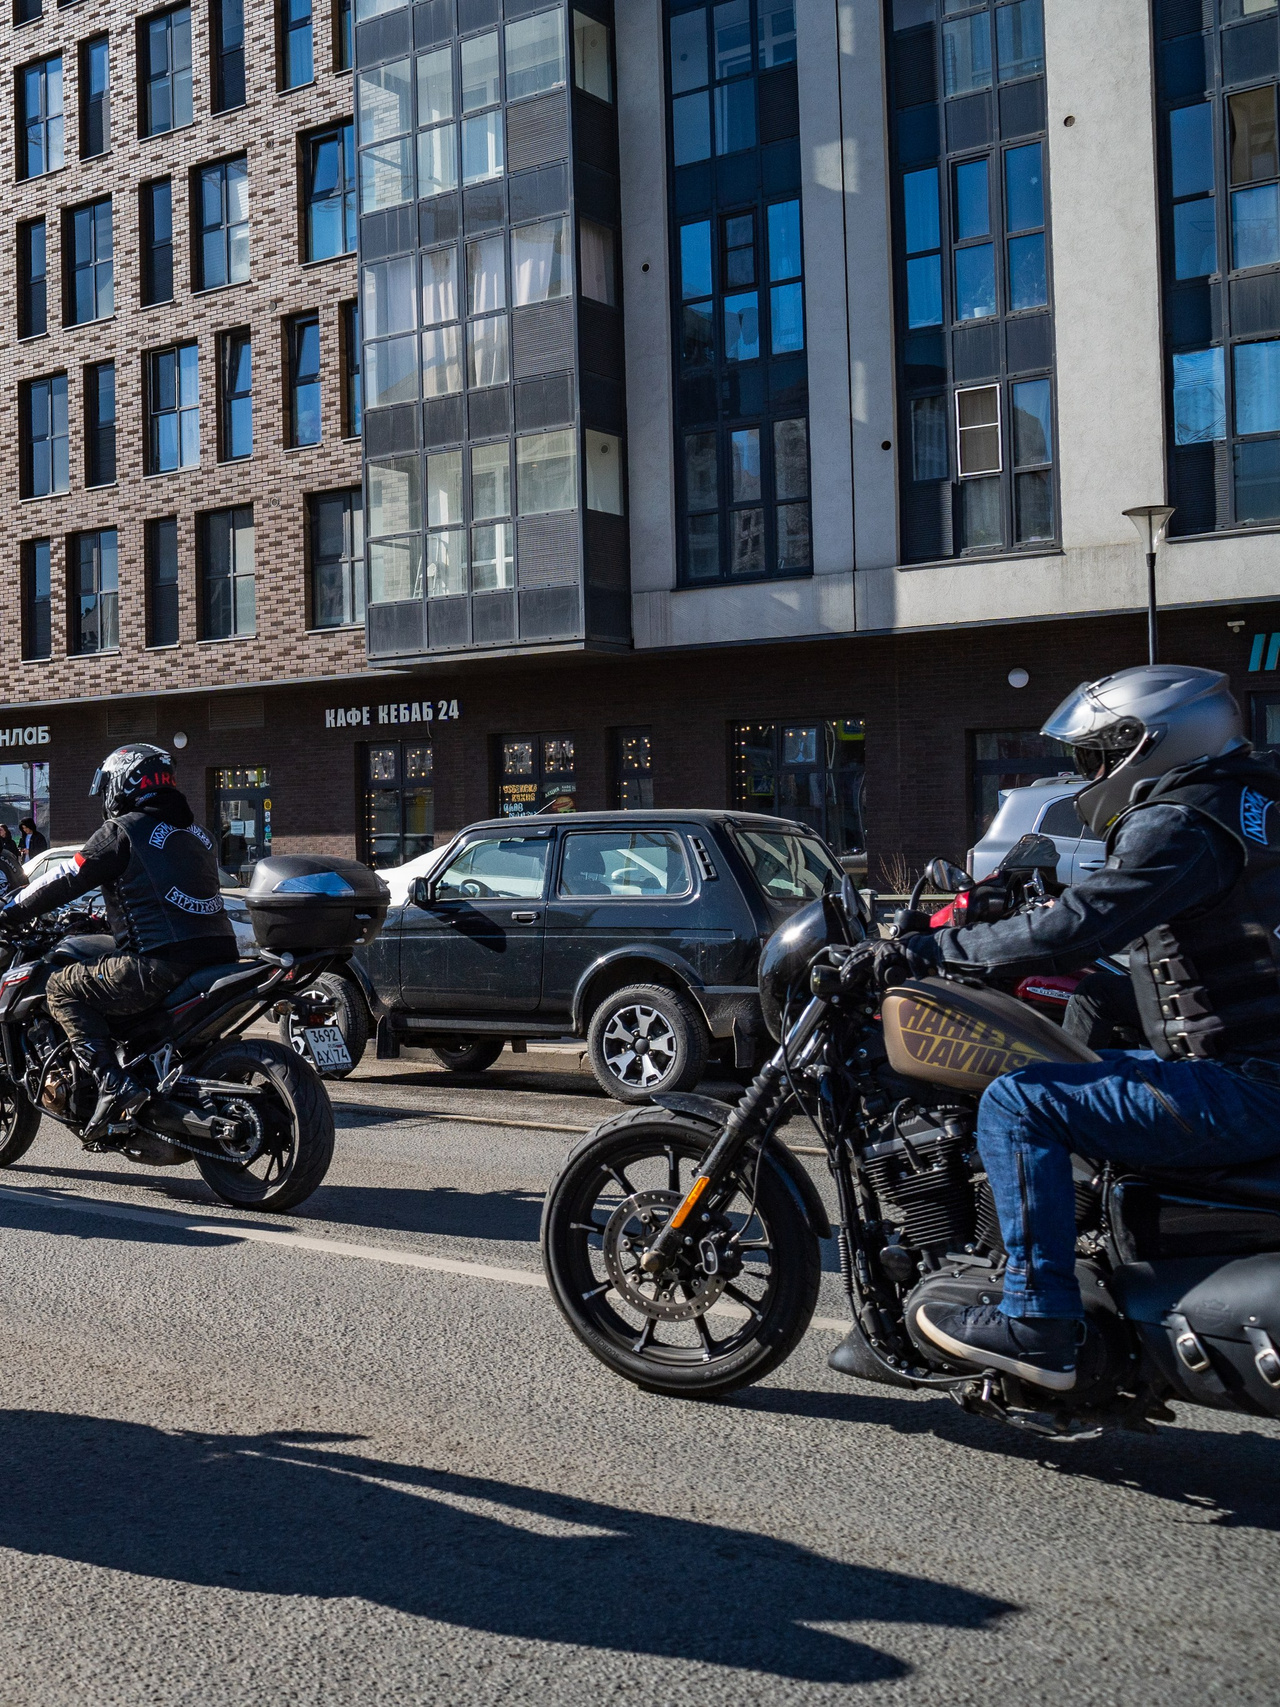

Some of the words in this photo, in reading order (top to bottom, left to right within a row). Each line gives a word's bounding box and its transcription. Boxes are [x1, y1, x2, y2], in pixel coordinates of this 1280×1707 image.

[325, 706, 370, 728] КАФЕ
[378, 701, 433, 725] КЕБАБ
[438, 699, 460, 720] 24
[310, 1029, 339, 1043] 3692
[333, 1048, 349, 1062] 74
